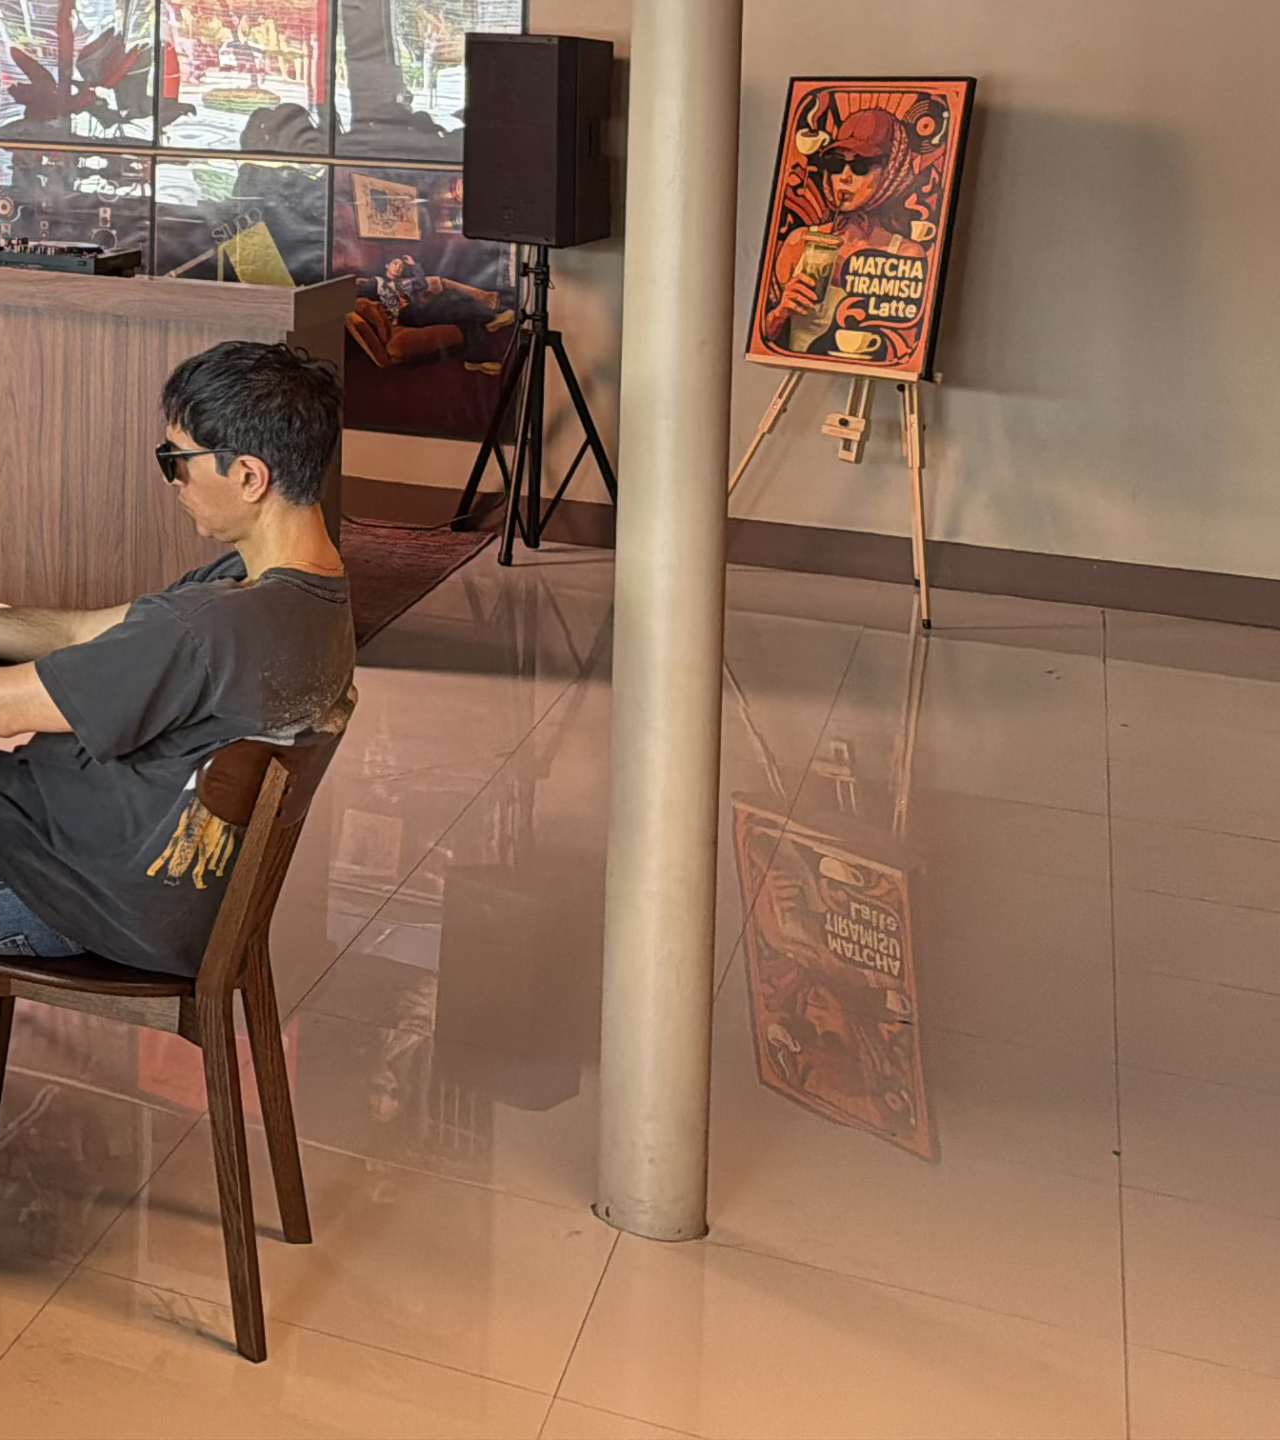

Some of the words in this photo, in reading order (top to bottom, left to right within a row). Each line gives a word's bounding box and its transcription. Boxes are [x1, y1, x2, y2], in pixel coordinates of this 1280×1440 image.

[848, 255, 924, 280] MATCHA
[844, 274, 923, 298] TIRAMISU
[867, 297, 917, 319] Latte
